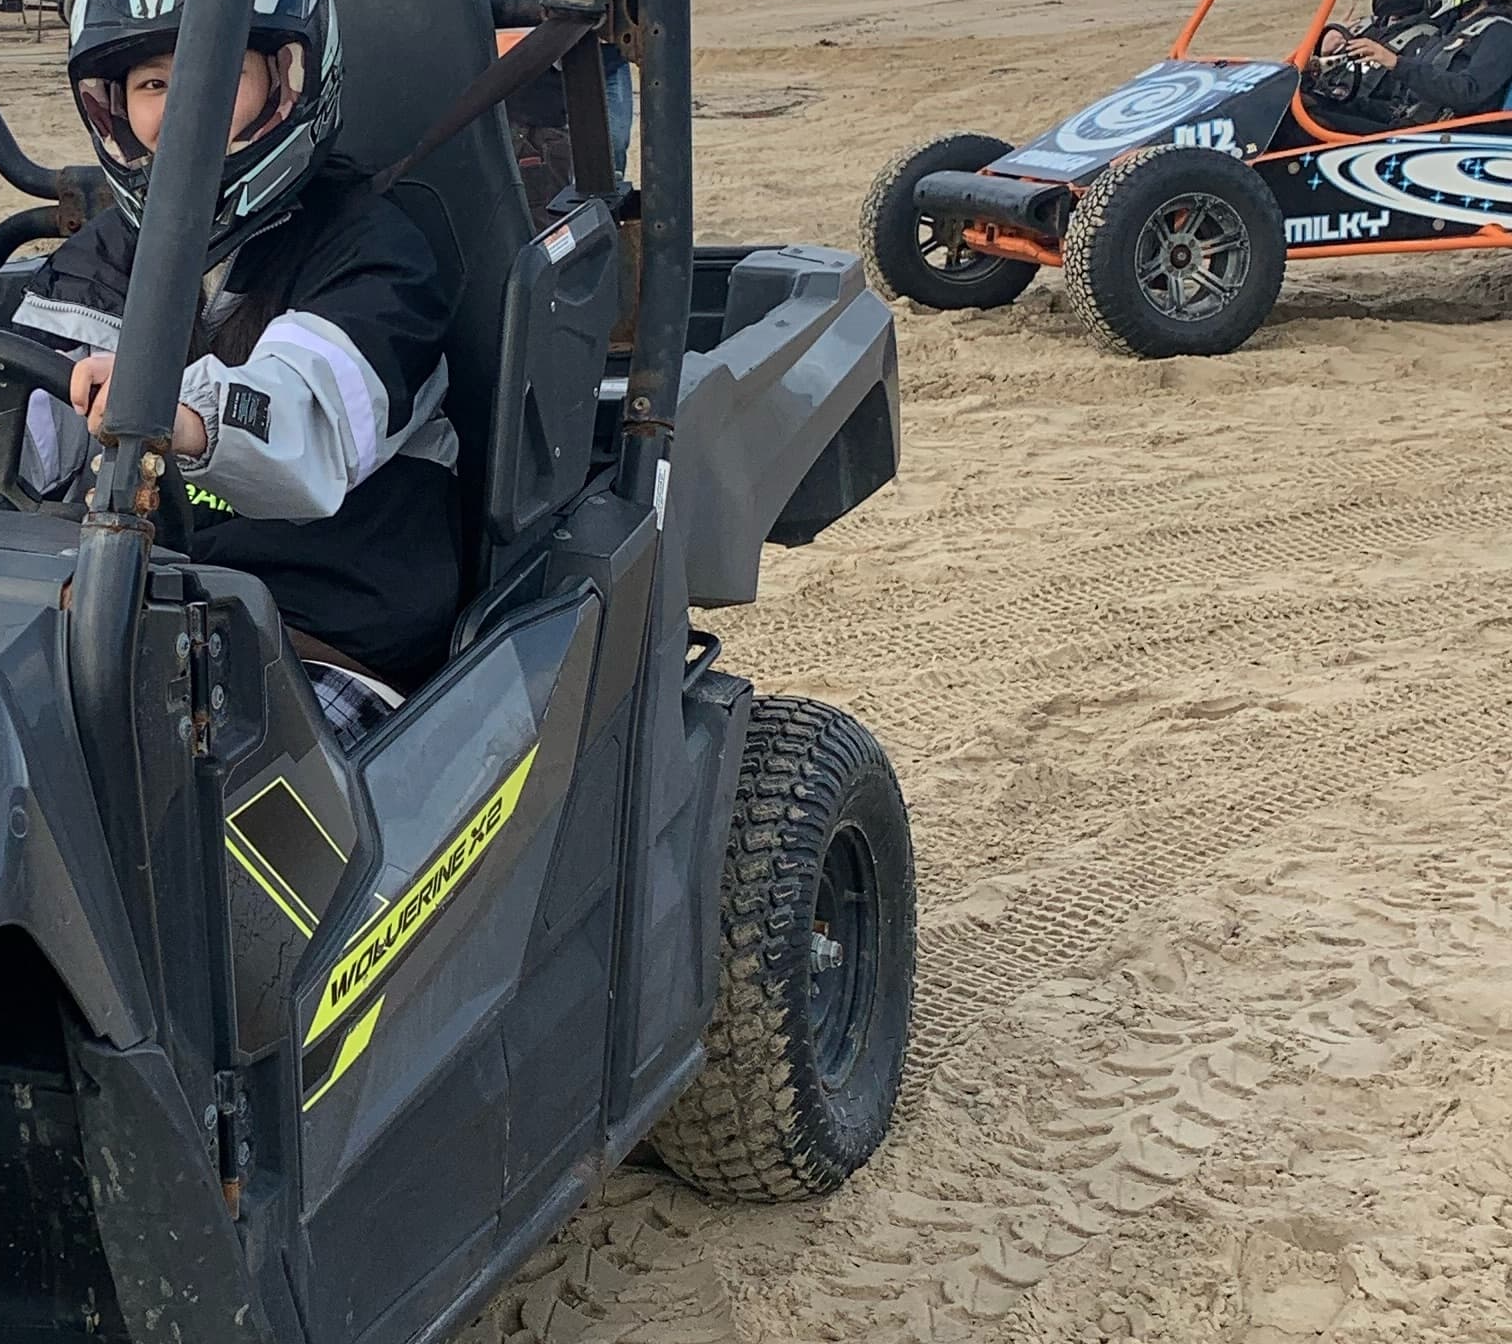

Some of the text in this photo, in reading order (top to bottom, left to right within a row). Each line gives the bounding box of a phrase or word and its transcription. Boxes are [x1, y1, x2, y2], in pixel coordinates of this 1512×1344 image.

[1284, 209, 1390, 243] MILKY
[330, 797, 505, 1008] WOLVERINE X2
